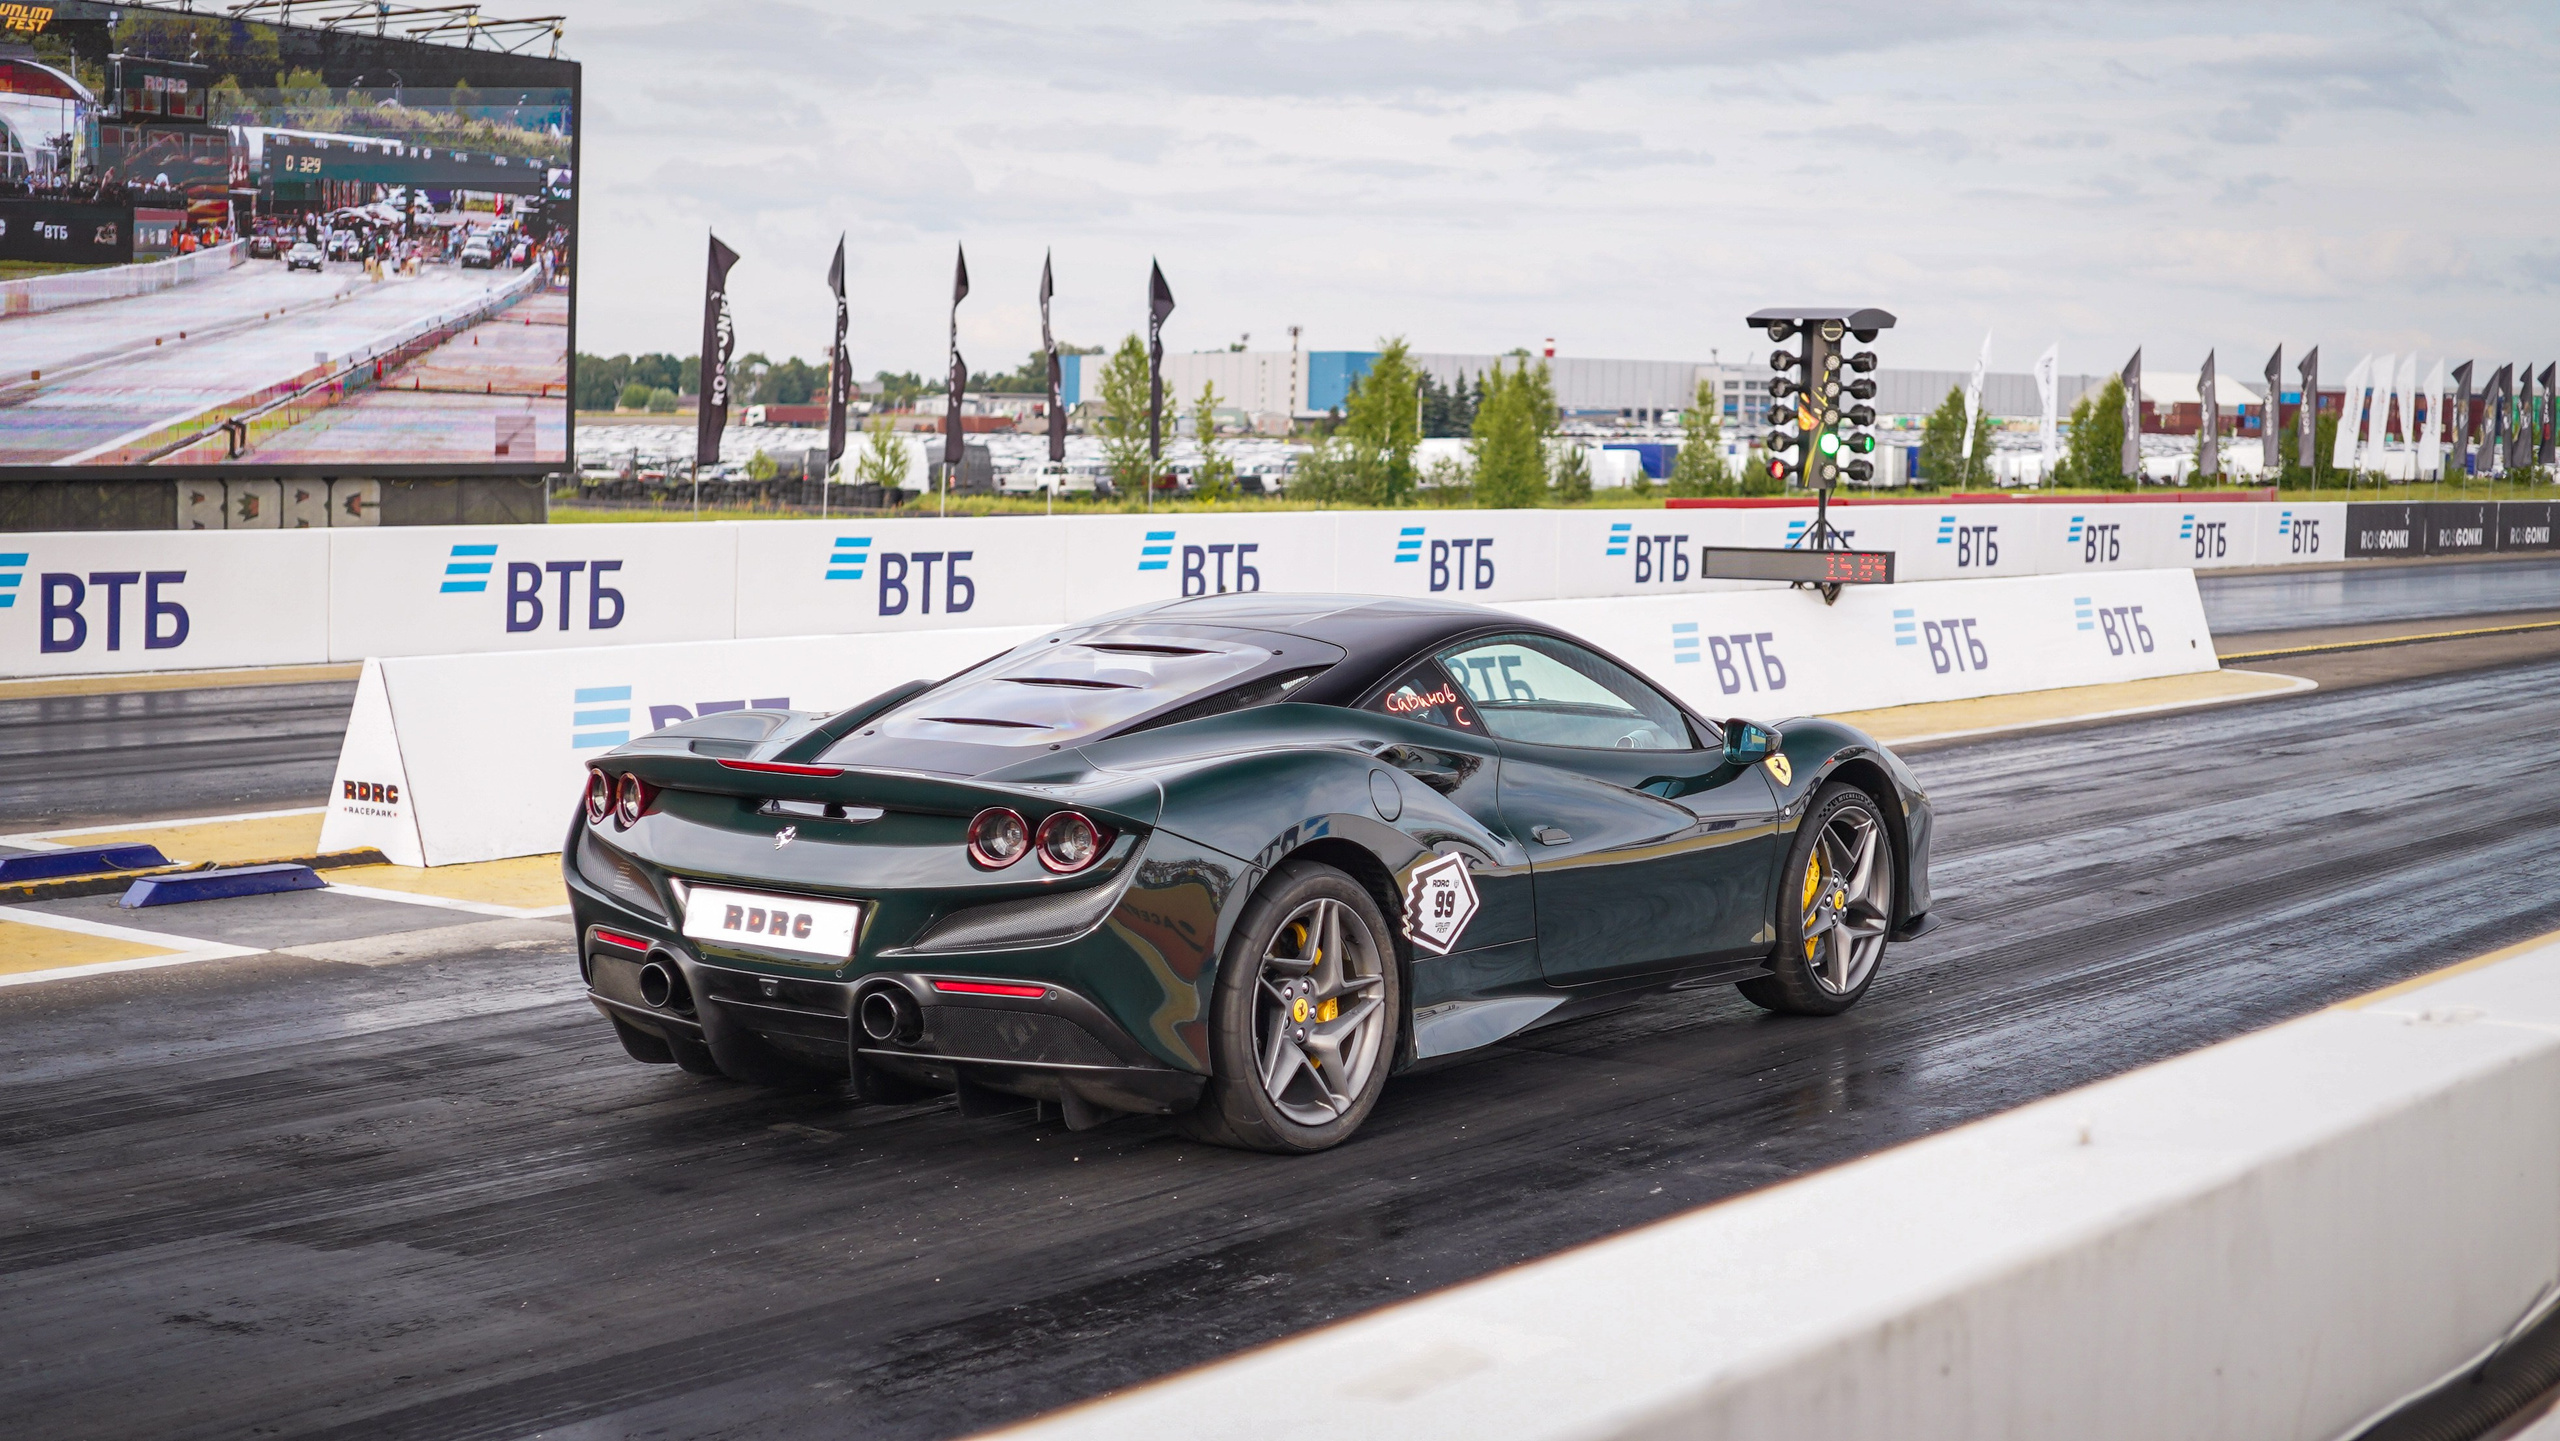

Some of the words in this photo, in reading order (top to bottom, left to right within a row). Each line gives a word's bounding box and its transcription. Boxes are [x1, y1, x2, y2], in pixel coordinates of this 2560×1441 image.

[0, 3, 53, 20] UNLIM
[5, 16, 47, 32] FEST
[44, 224, 69, 241] ВТБ
[1958, 525, 1999, 568] ВТБ
[2085, 524, 2121, 564] ВТБ
[2195, 521, 2227, 560] ВТБ
[2292, 520, 2320, 554] ВТБ
[2361, 529, 2409, 550] ROSGONKI
[2439, 527, 2483, 547] ROSGONKI
[2510, 526, 2550, 545] ROSGONKI
[1182, 543, 1260, 597] ВТБ
[1429, 538, 1494, 592] ВТБ
[1635, 535, 1690, 583] ВТБ
[506, 560, 625, 633] ВТБ
[878, 551, 976, 617] ВТБ
[40, 570, 190, 655] ВТБ
[1922, 618, 1988, 675] ВТБ
[2098, 605, 2155, 656] ВТБ
[1707, 632, 1787, 695] ВТБ
[343, 780, 398, 804] RDRC
[1838, 792, 1865, 802] MICHELIN
[348, 806, 392, 818] RACEPARK
[1432, 879, 1450, 888] RDRC
[723, 904, 813, 939] RDRC
[1434, 890, 1456, 918] 99
